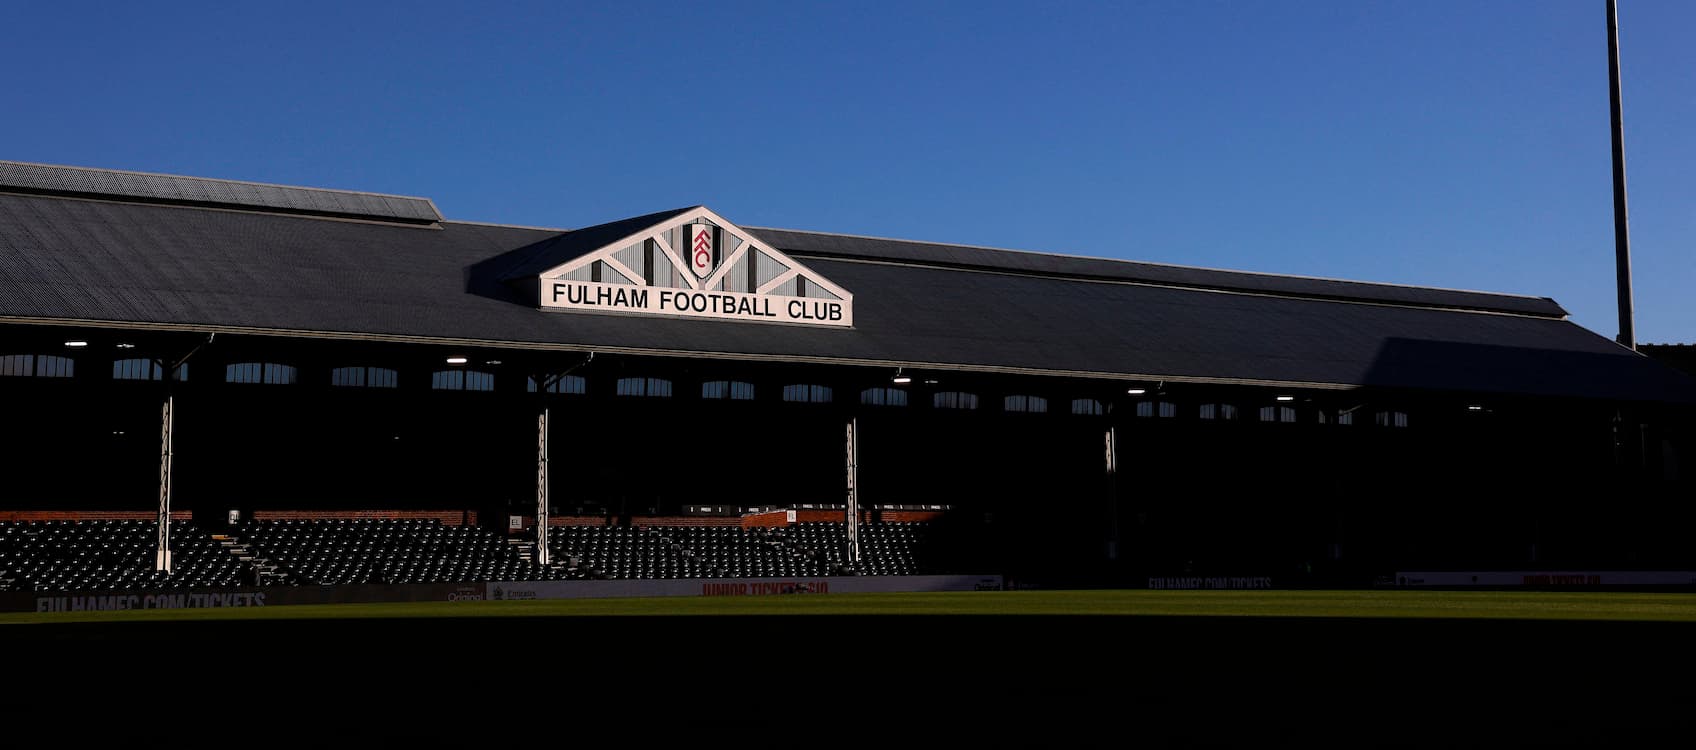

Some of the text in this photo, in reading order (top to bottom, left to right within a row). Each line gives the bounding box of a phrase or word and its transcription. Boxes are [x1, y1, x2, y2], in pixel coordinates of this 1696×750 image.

[694, 229, 710, 268] FFC
[553, 284, 842, 321] FULHAM FOOTBALL CLUB
[1148, 577, 1271, 589] FULHAMFCCOM/TICKETS
[36, 592, 266, 612] FULHAMFCCOM/TICKETS
